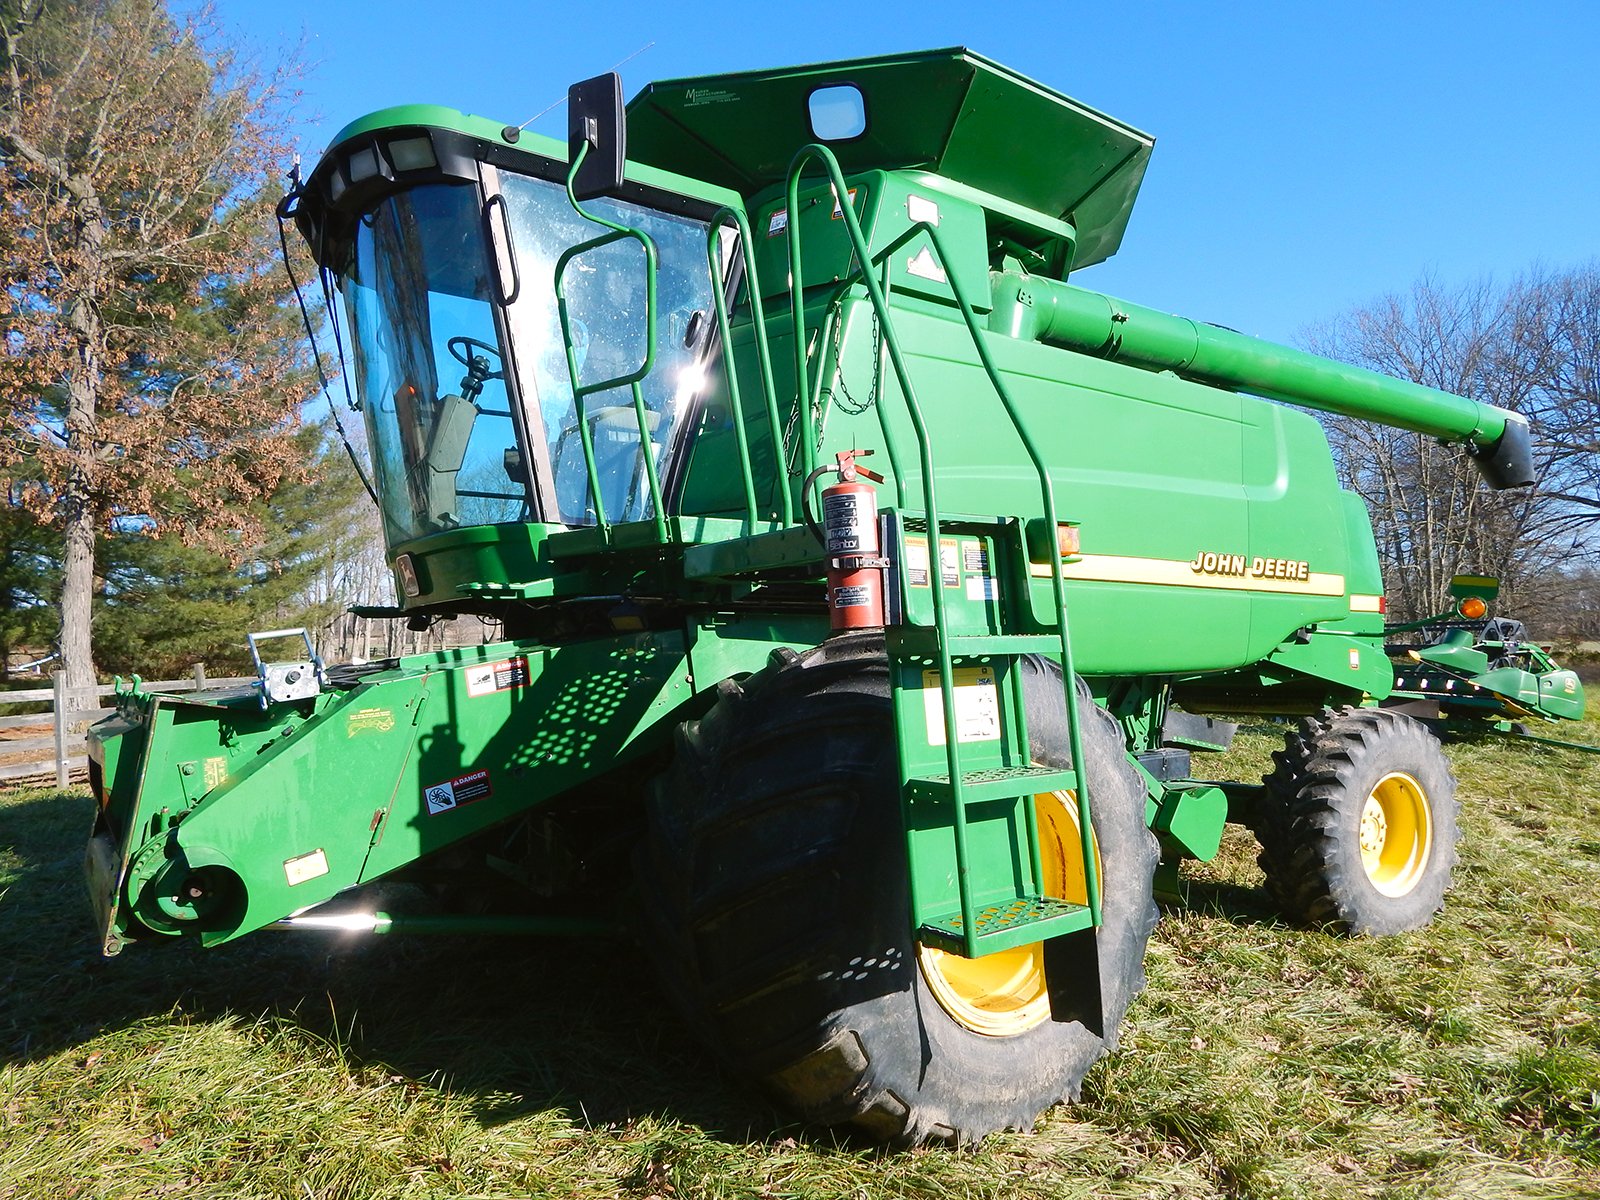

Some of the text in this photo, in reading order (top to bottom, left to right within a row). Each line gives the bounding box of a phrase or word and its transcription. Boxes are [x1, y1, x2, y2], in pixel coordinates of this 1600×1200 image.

[1190, 551, 1309, 581] JOHN DEERE
[459, 771, 487, 785] DANGER
